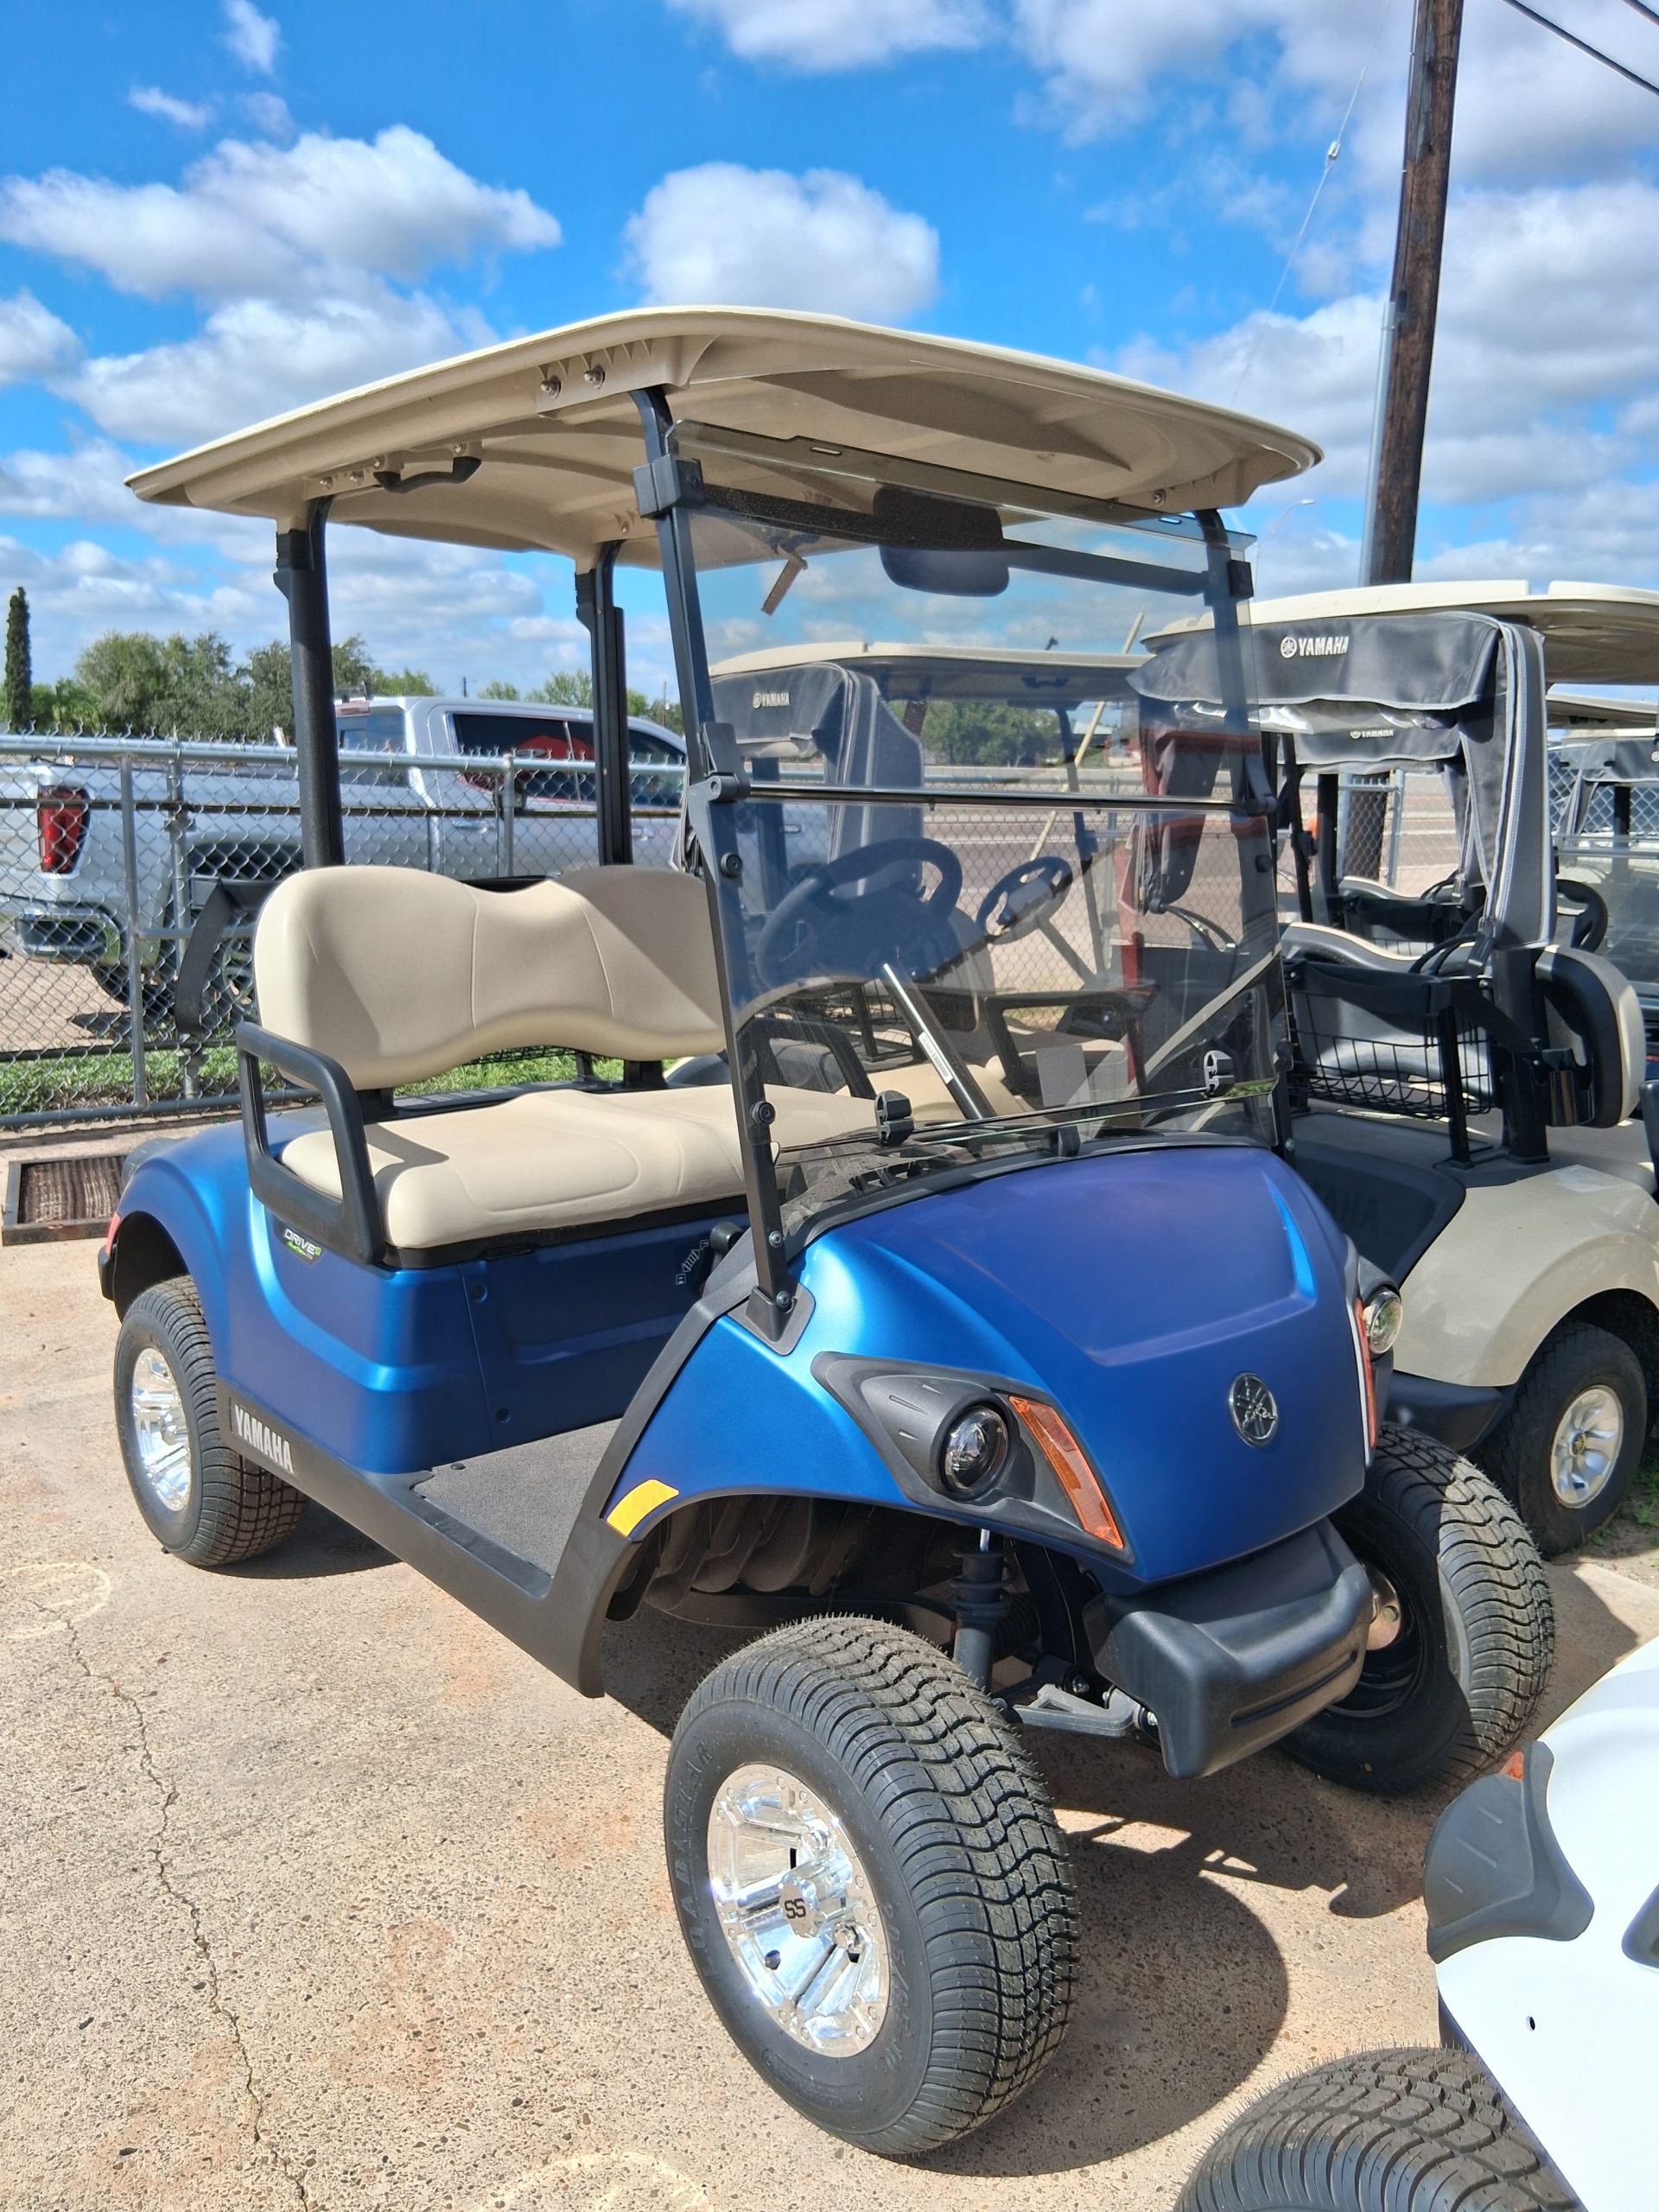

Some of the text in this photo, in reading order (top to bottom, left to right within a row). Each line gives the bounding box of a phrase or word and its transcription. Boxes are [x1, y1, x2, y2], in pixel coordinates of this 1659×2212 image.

[1298, 635, 1350, 657] YAMAHA
[761, 691, 790, 708] YAMAHA
[699, 1238, 709, 1251] F
[675, 1273, 687, 1286] R
[234, 1403, 295, 1475] YAMAHA
[784, 1897, 807, 1919] SS
